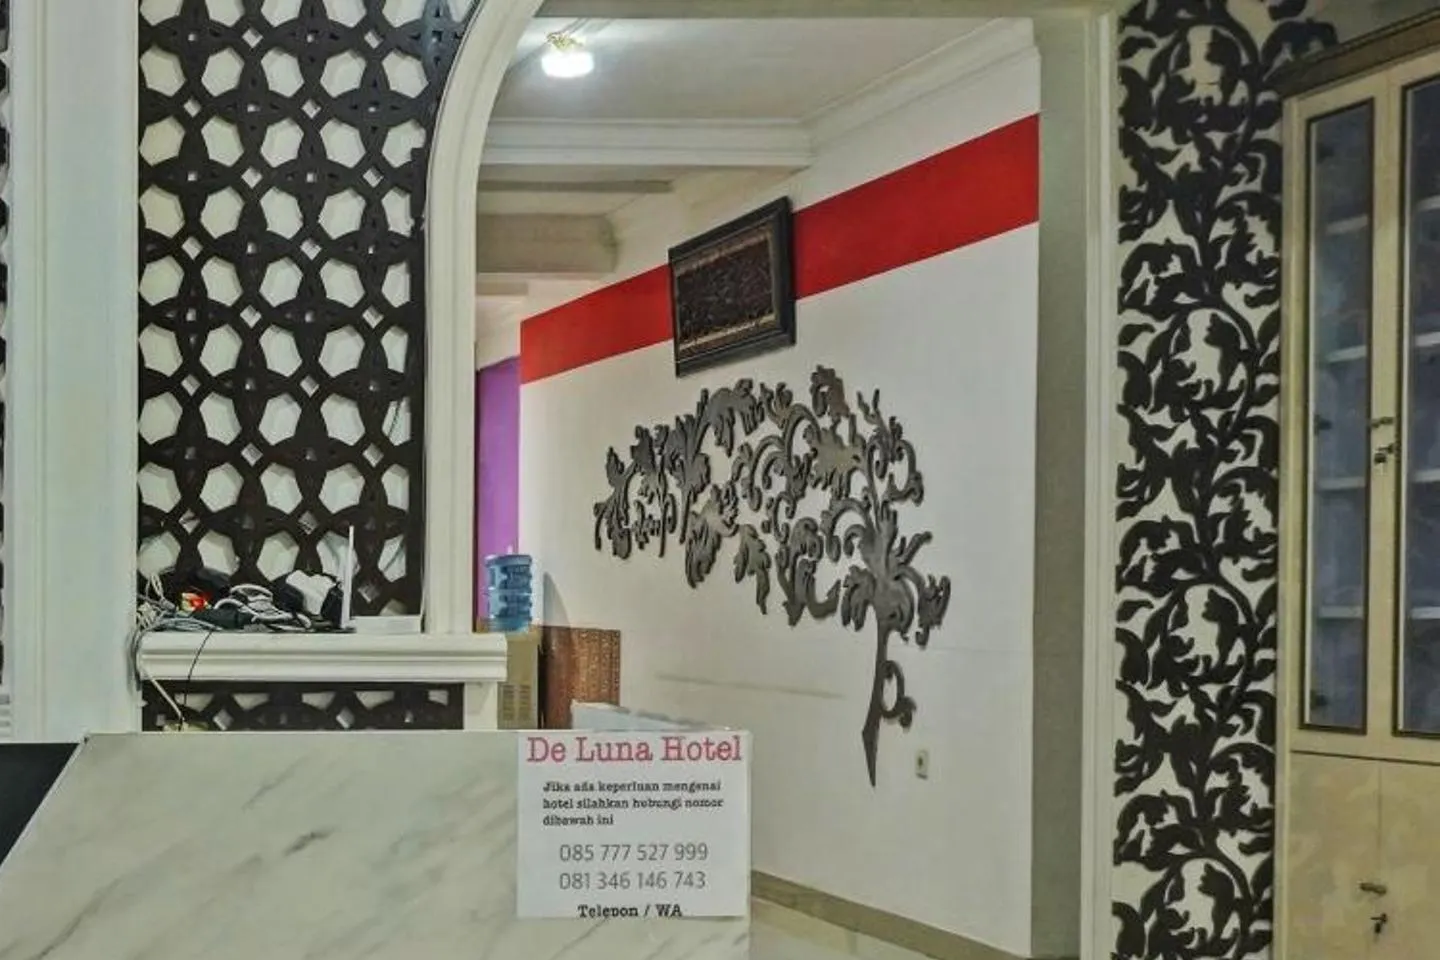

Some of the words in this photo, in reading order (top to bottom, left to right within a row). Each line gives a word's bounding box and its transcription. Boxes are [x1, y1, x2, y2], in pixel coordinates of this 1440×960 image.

[526, 736, 566, 763] De
[575, 736, 654, 763] Luna
[660, 734, 742, 763] Hotel
[542, 780, 571, 793] Jika
[574, 780, 595, 793] ada
[598, 780, 660, 794] keperluan
[662, 779, 722, 794] mengenai
[542, 798, 574, 810] hotel
[576, 797, 629, 809] silahkan
[542, 814, 595, 826] dibawah
[597, 813, 614, 826] ini
[559, 843, 594, 862] 085
[600, 843, 632, 861] 777
[636, 843, 669, 861] 527
[674, 842, 709, 861] 999
[559, 872, 591, 890] 081
[597, 871, 631, 890] 346
[637, 871, 668, 890] 146
[674, 870, 707, 890] 743
[655, 903, 683, 918] WA
